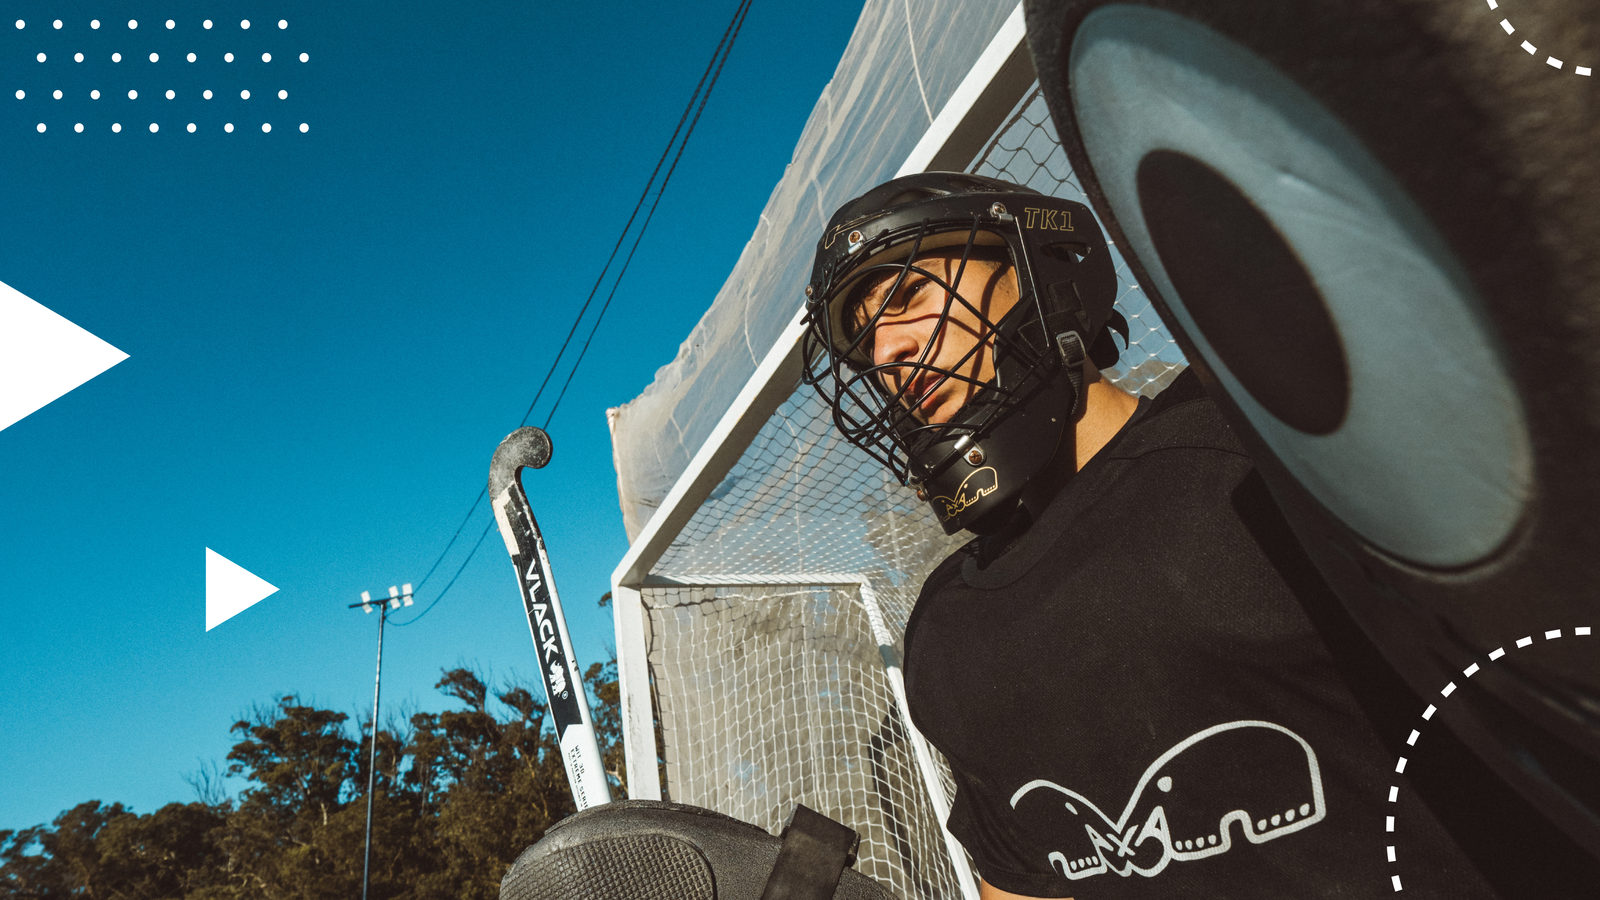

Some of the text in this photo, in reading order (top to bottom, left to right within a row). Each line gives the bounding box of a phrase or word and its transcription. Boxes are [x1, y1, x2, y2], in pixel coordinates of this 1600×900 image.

[1024, 207, 1074, 231] TK1
[525, 558, 559, 664] VLACK
[570, 748, 582, 783] EXTREME
